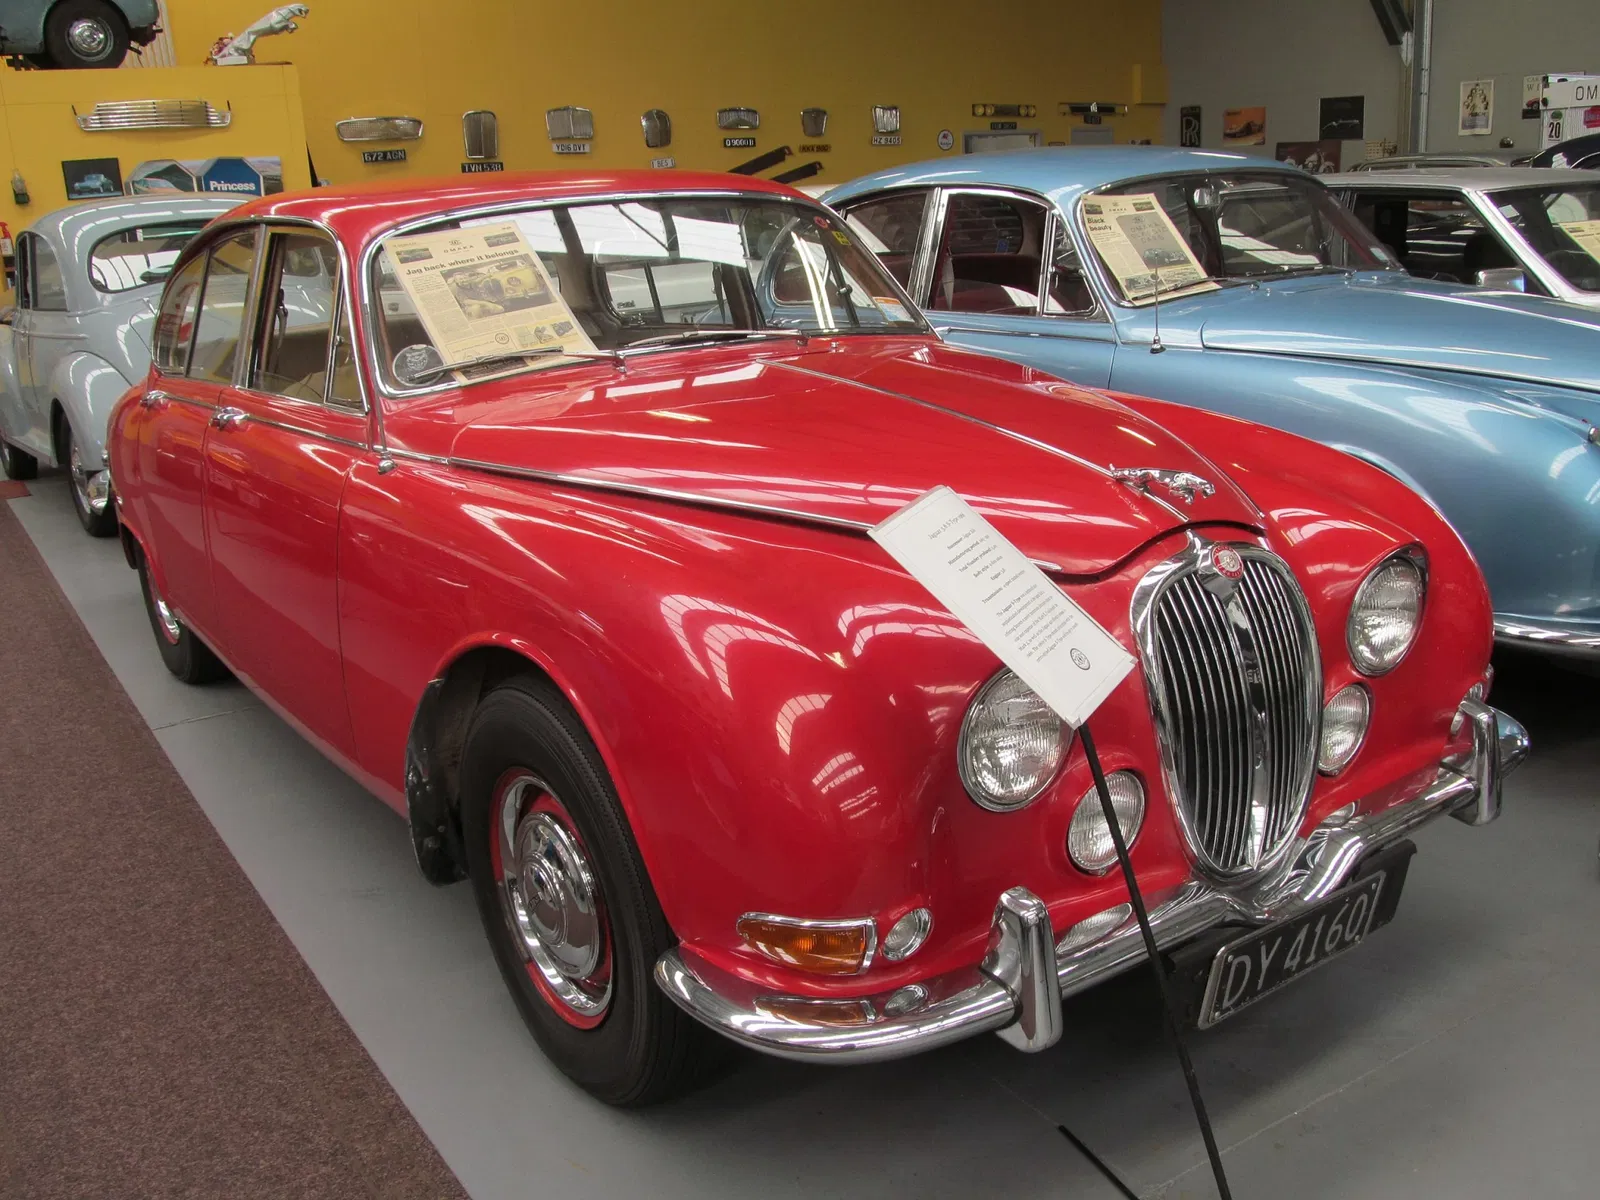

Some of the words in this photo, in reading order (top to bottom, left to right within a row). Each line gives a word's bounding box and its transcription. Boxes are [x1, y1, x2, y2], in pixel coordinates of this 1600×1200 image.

[1548, 121, 1561, 138] 20
[364, 152, 384, 162] 672
[386, 150, 405, 160] AGN
[465, 163, 482, 172] TVN
[209, 180, 256, 191] Princess
[443, 244, 475, 254] OMAKA
[406, 267, 423, 276] Jag
[424, 263, 446, 273] back
[448, 257, 476, 267] where
[485, 248, 519, 260] belongs
[1222, 936, 1282, 1010] DY
[1283, 893, 1369, 971] 4160
